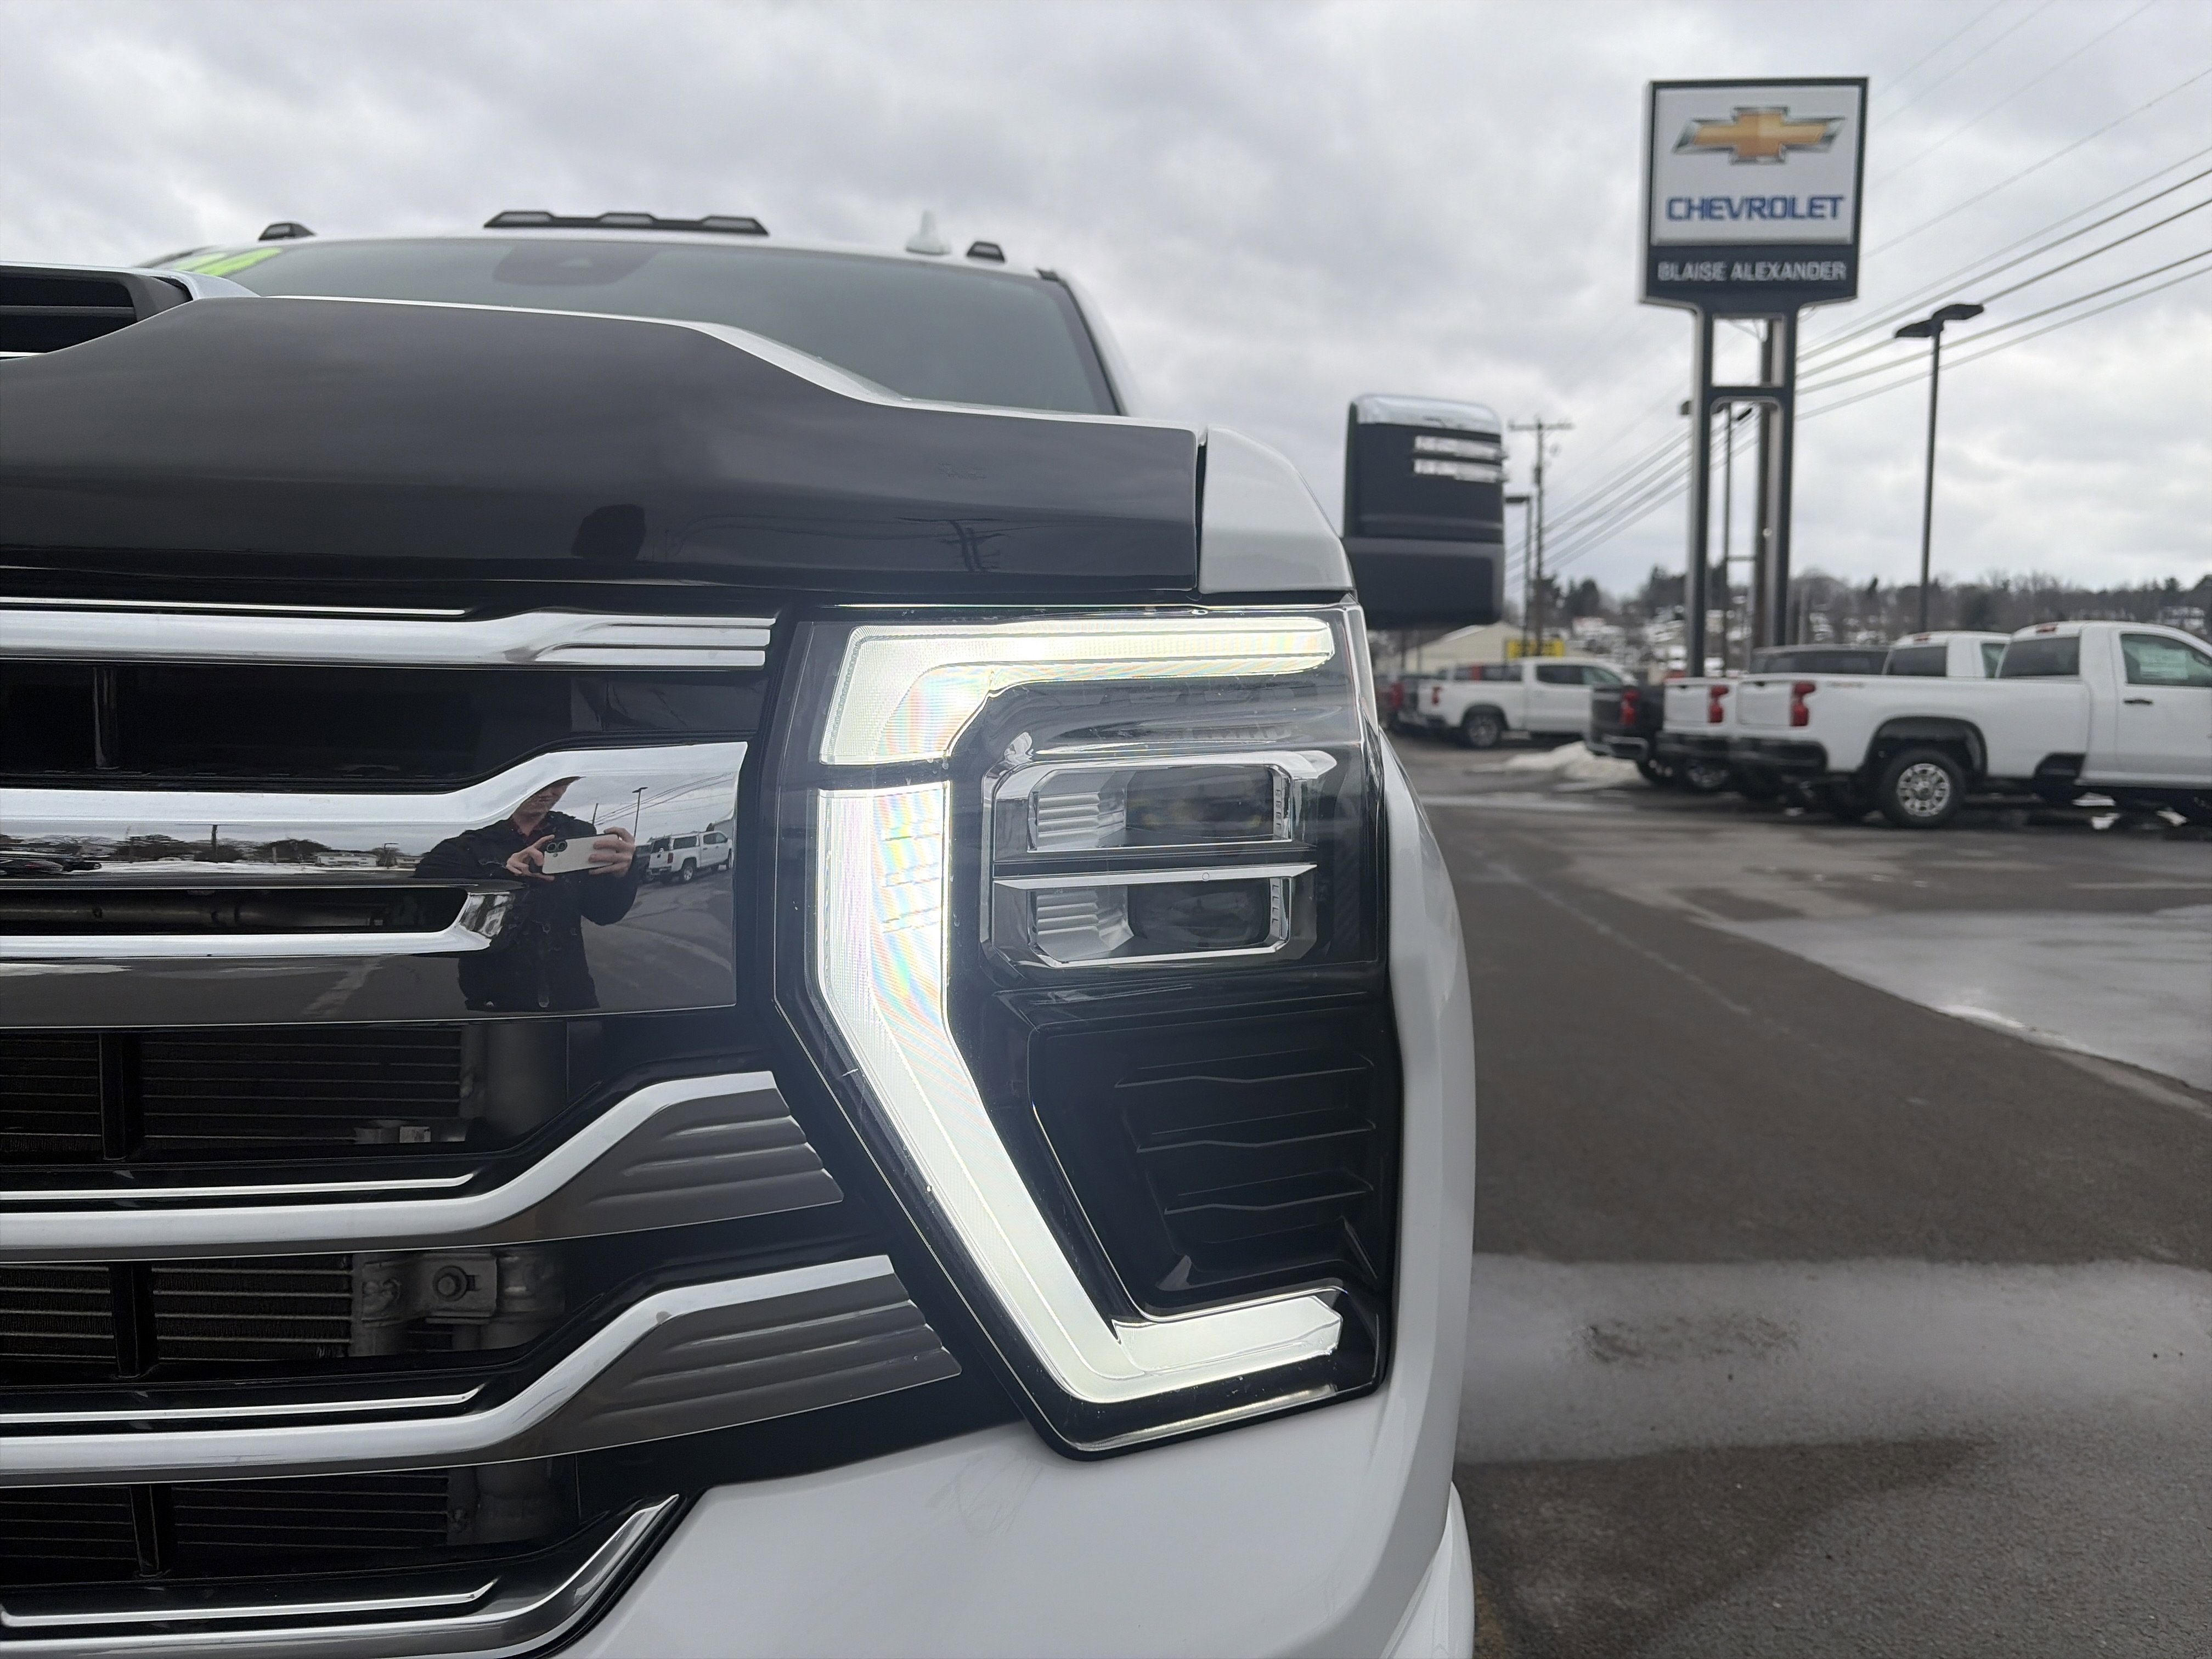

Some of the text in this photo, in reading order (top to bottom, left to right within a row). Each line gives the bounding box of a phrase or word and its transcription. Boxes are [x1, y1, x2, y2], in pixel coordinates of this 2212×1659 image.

[1666, 195, 1844, 221] CHEVROLET
[1657, 260, 1847, 281] BLAISE ALEXANDER
